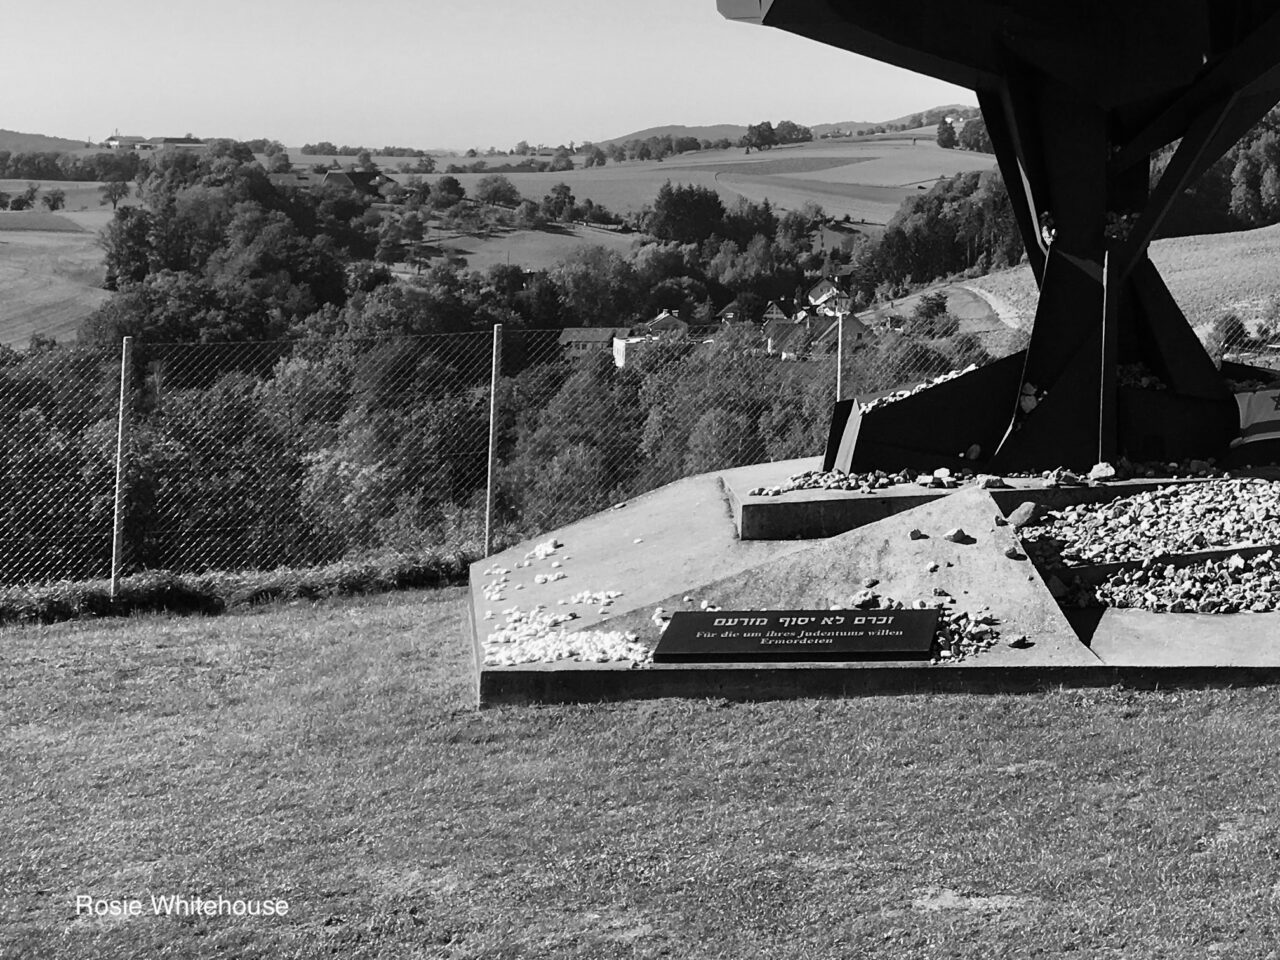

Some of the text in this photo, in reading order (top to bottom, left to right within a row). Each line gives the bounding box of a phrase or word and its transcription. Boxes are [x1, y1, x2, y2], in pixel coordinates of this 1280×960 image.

[778, 617, 816, 628] יסוף
[820, 615, 845, 625] לא
[797, 630, 865, 639] Judentums
